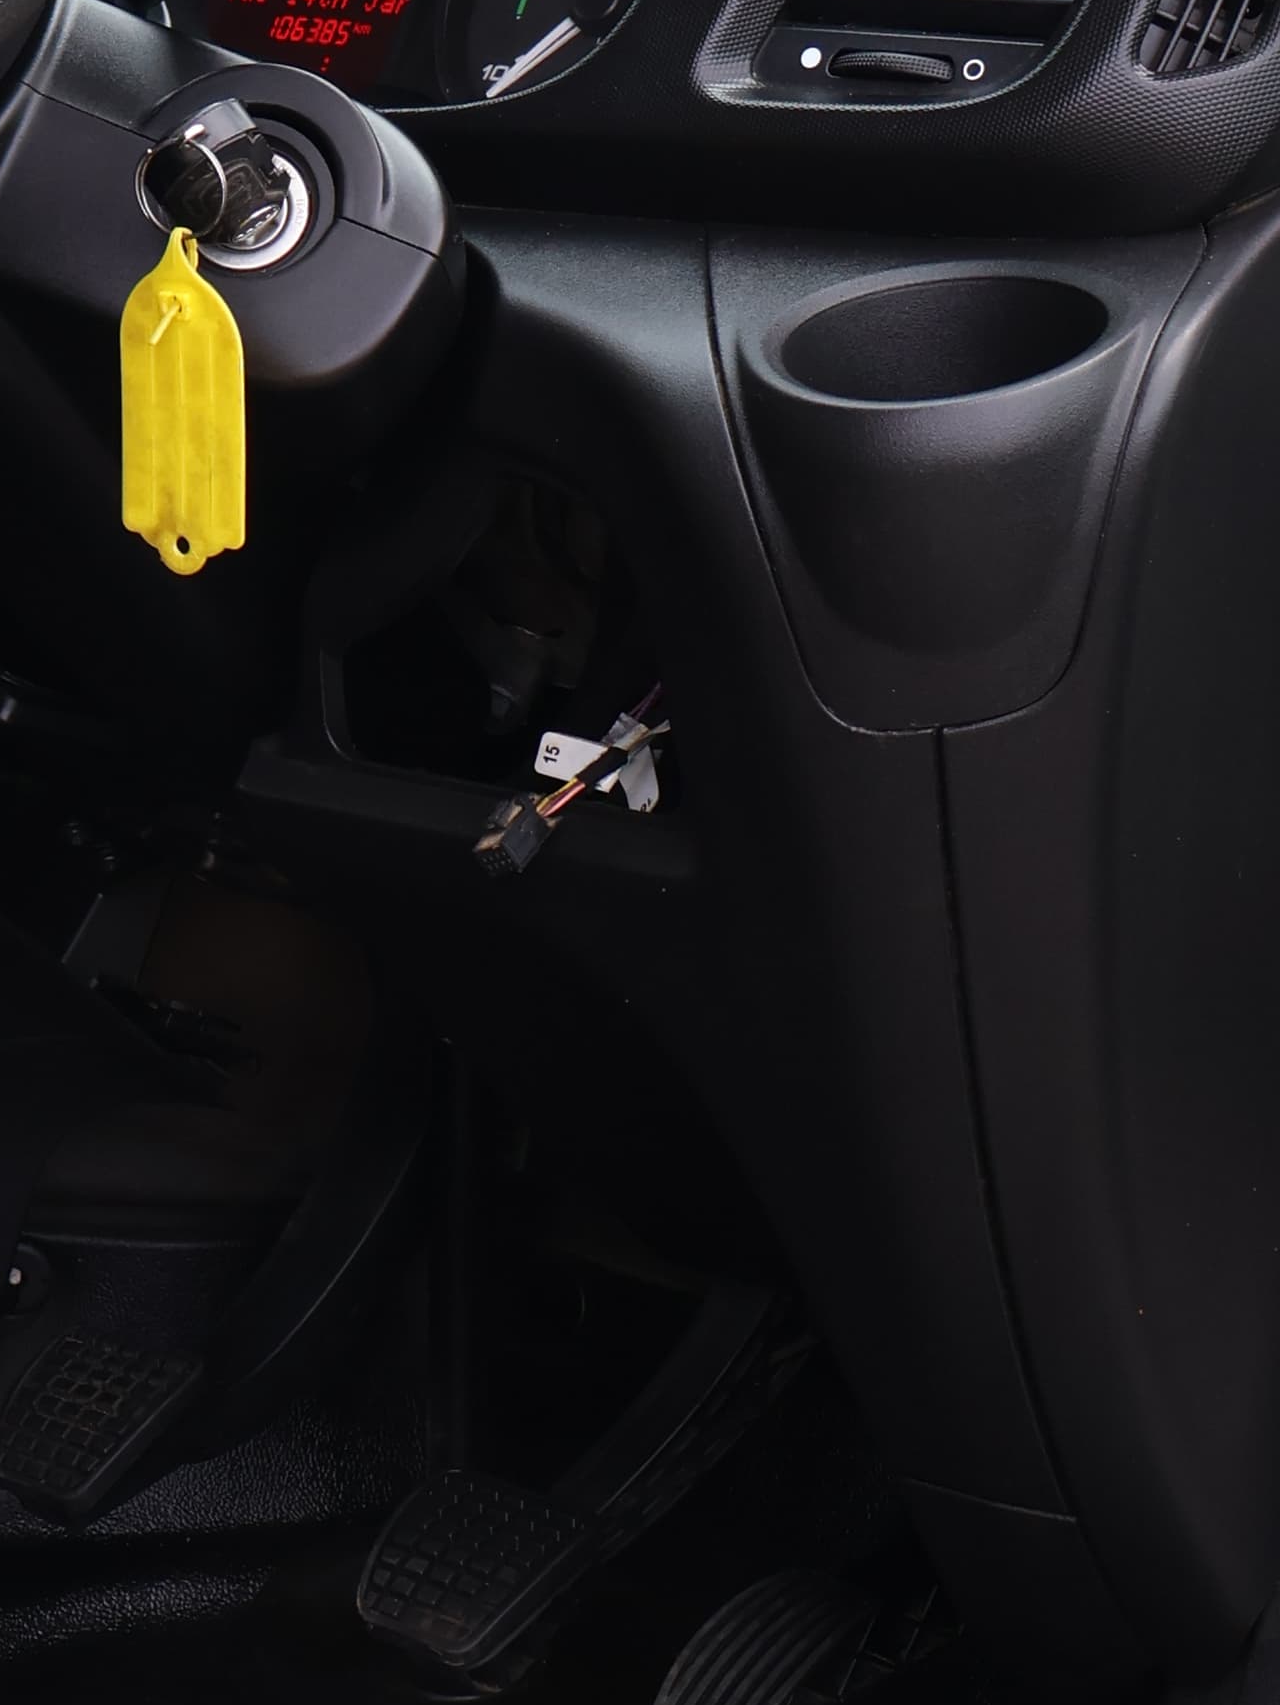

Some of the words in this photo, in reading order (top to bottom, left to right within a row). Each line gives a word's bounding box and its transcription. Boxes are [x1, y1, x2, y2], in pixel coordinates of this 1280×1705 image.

[269, 15, 352, 46] 106385
[481, 63, 509, 81] 10
[542, 744, 561, 765] 15
